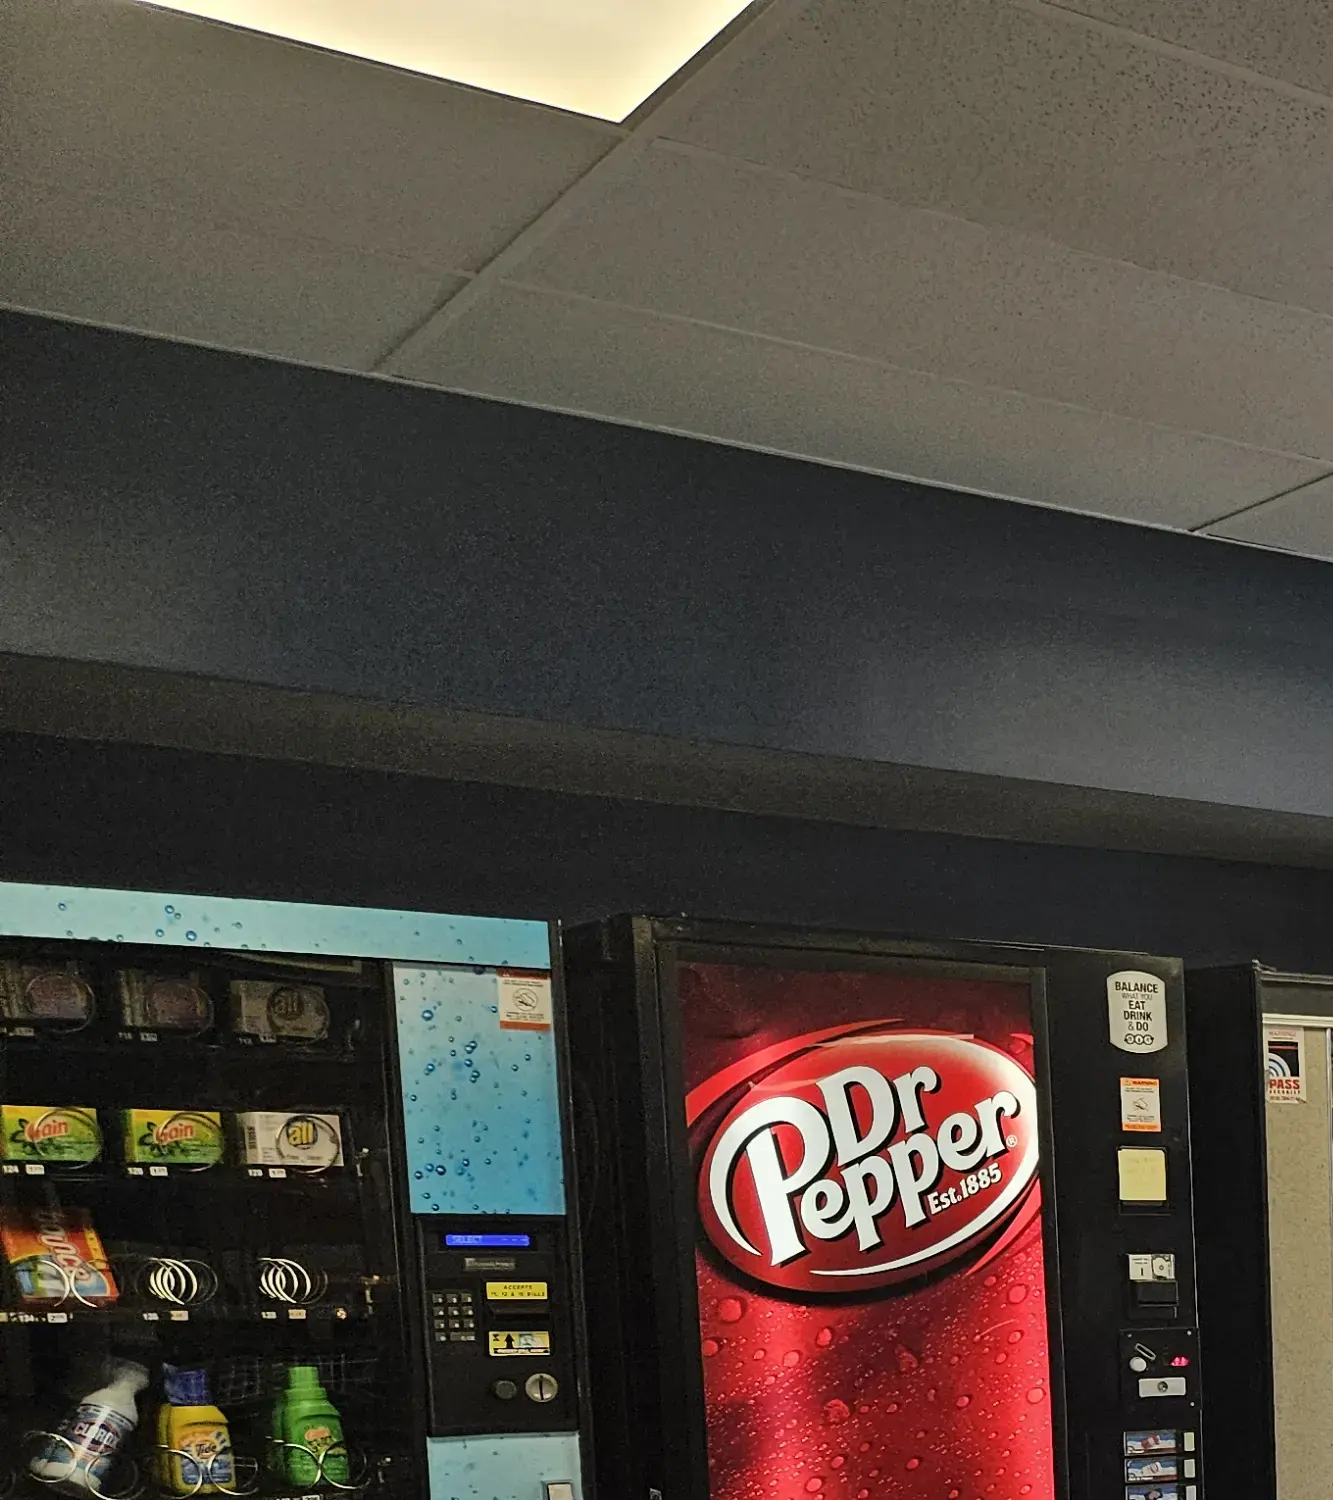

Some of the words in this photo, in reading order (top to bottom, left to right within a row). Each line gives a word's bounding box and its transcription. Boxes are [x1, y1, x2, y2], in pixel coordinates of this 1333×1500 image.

[1115, 982, 1159, 993] BALANCE
[1129, 1000, 1146, 1010] EAT
[1124, 1011, 1153, 1021] DRINK
[1128, 1021, 1134, 1031] &
[1136, 1022, 1149, 1031] DO
[1269, 1079, 1300, 1090] PASS
[816, 1065, 941, 1166] Dr
[709, 1090, 1020, 1267] Pepper
